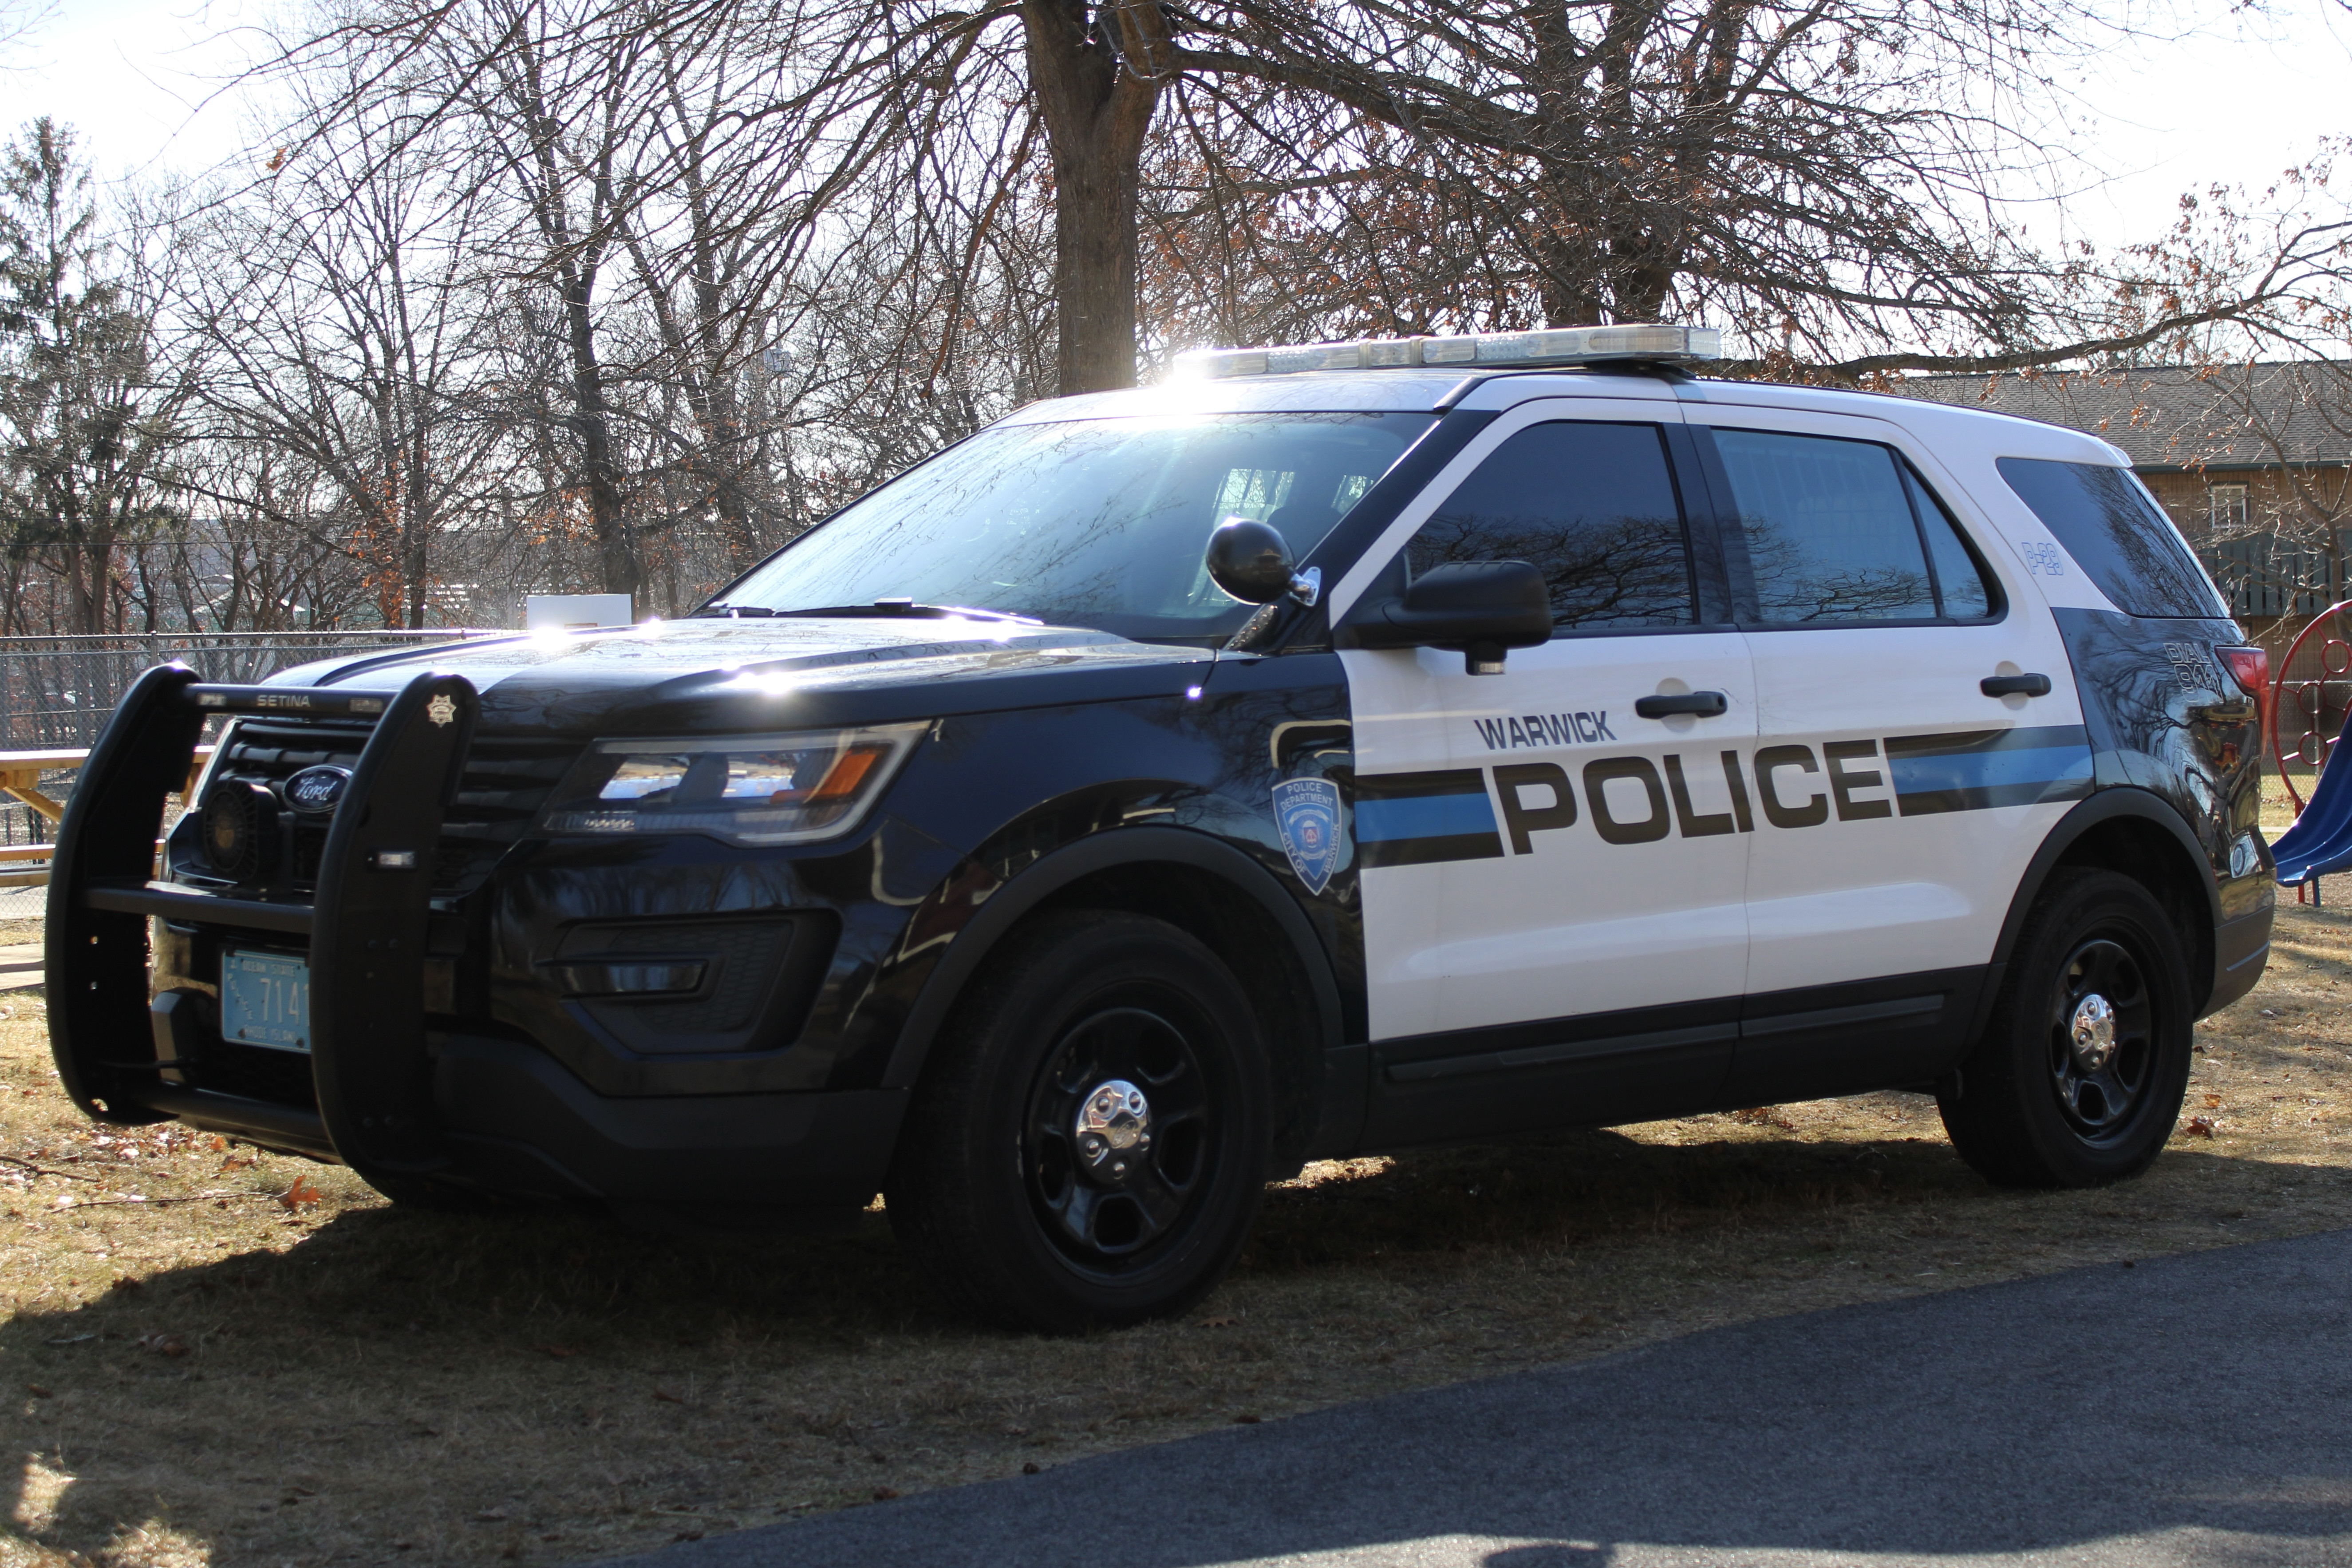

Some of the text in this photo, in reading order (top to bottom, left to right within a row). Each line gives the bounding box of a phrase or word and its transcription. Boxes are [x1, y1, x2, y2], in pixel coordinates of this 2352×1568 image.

[2021, 542, 2064, 576] P-29
[2163, 643, 2211, 663] DIAL
[2174, 664, 2224, 703] 911
[257, 695, 311, 707] SETINA
[1474, 711, 1617, 750] WARWICK
[295, 777, 338, 801] Ford
[1280, 793, 1334, 810] DEPARTMENT
[1287, 782, 1322, 795] POLICE
[1492, 739, 1893, 855] POLICE
[1283, 832, 1308, 873] CITY OF
[1323, 823, 1340, 873] WARWICK
[270, 964, 295, 978] STATE
